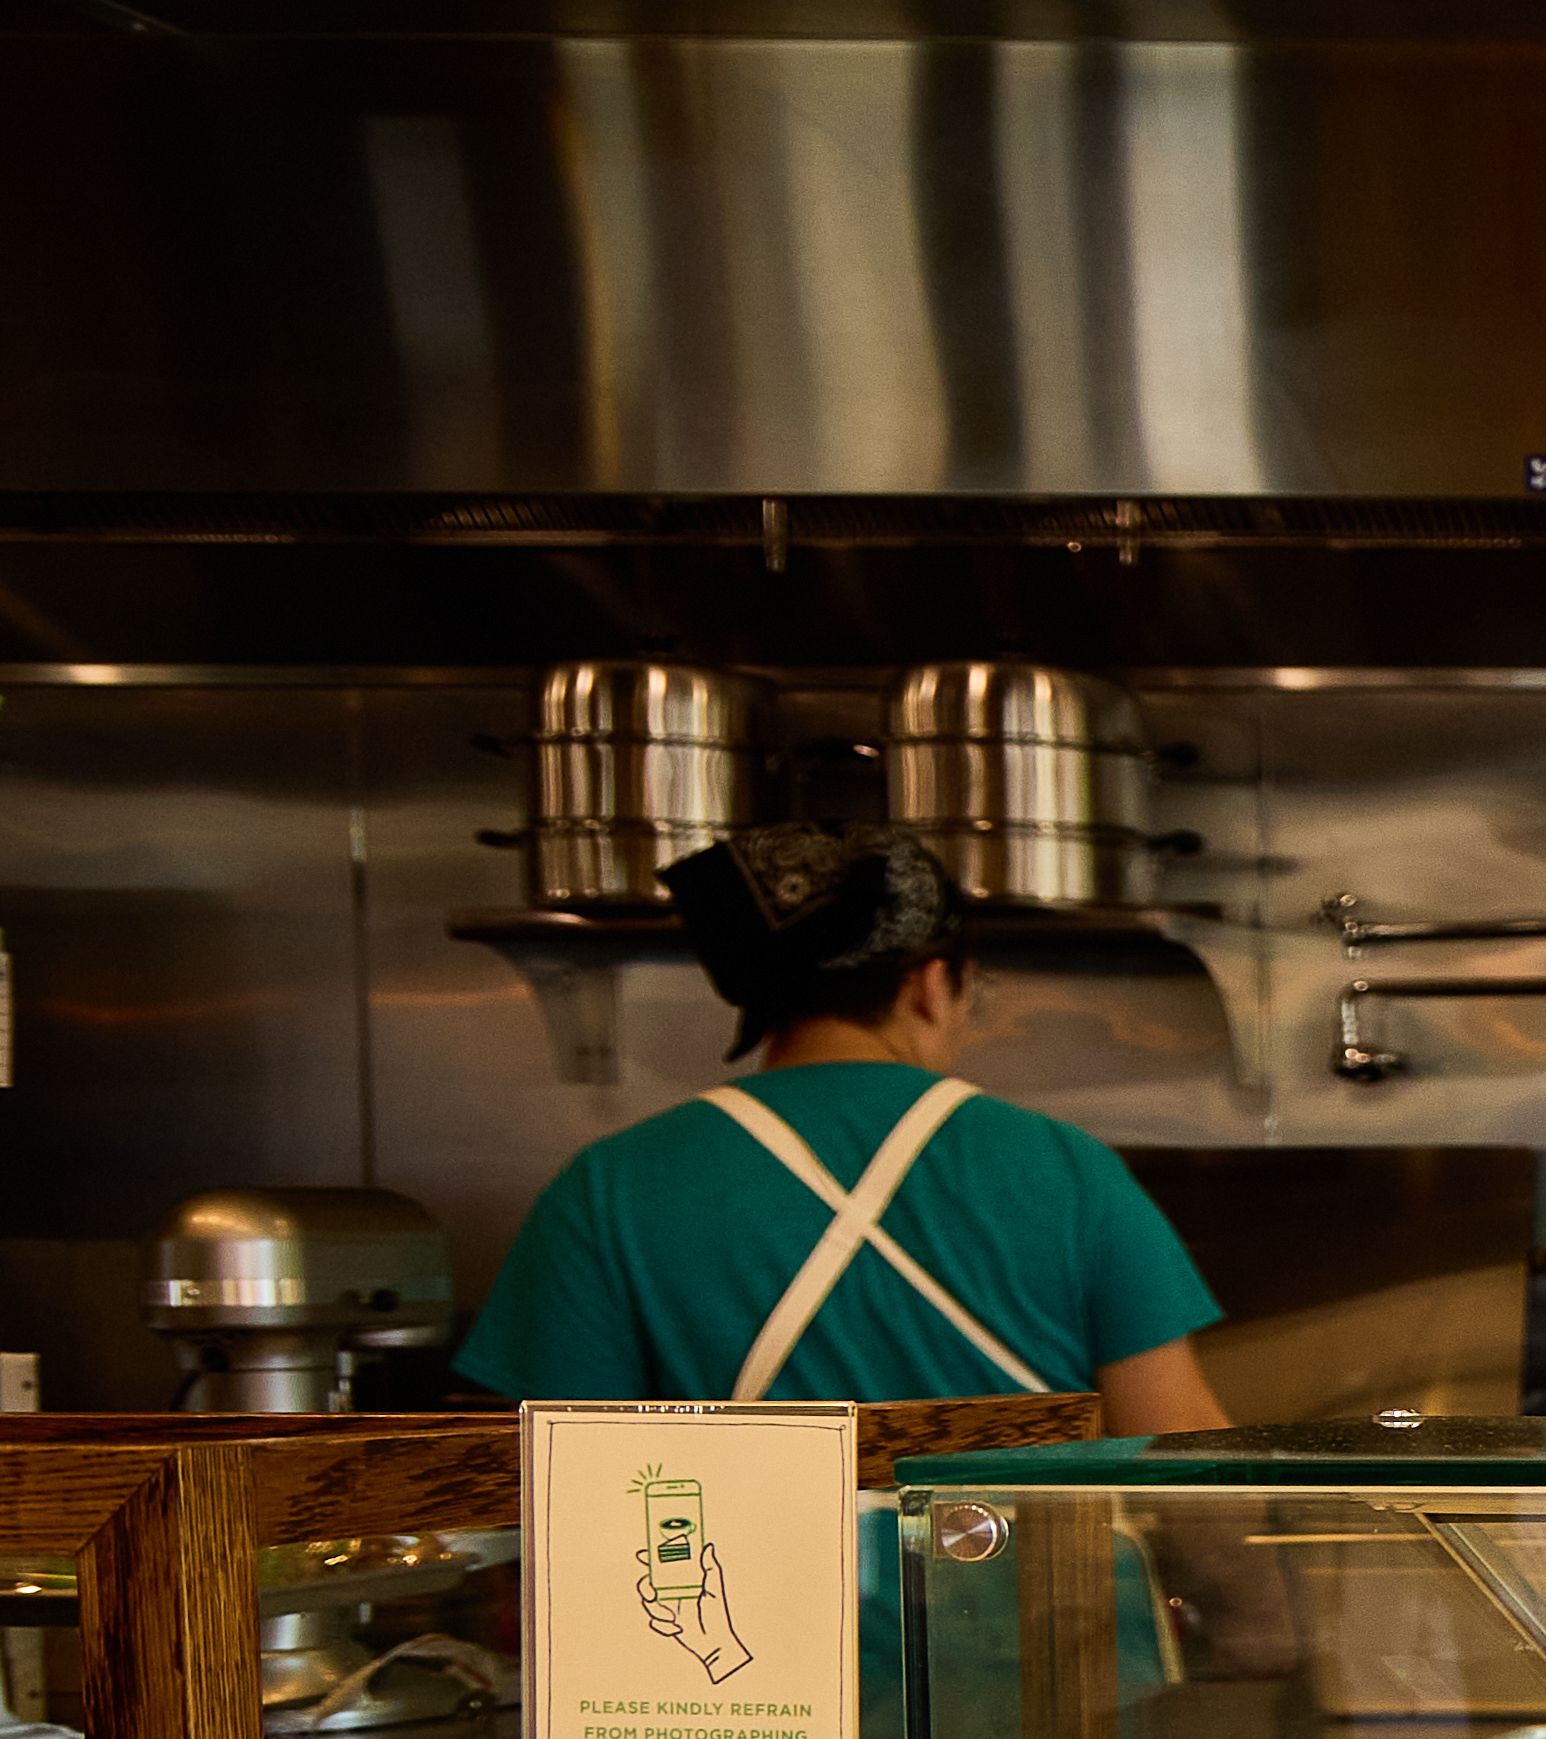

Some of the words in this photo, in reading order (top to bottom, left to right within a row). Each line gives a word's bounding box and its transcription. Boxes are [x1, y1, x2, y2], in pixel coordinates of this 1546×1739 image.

[579, 1699, 650, 1715] PLEASE
[656, 1701, 723, 1716] KINDLY
[730, 1702, 812, 1717] REFRAIN
[584, 1725, 637, 1739] FROM
